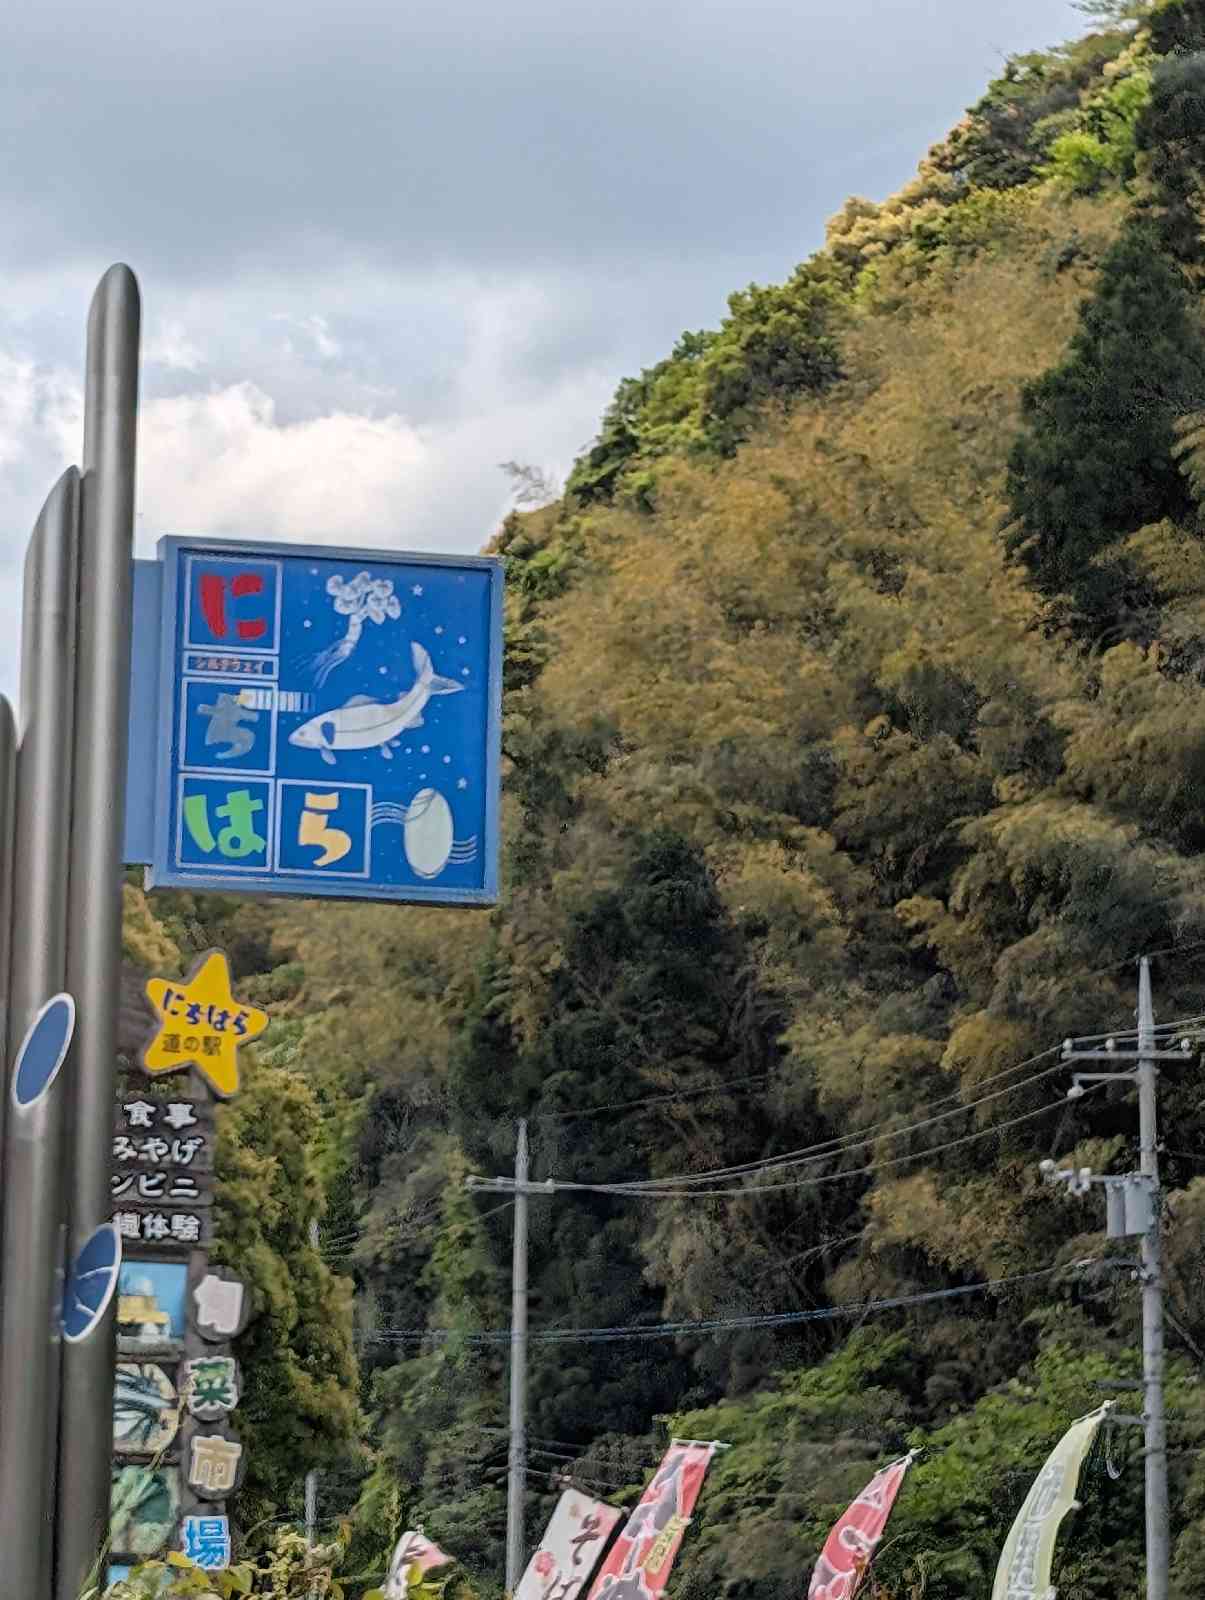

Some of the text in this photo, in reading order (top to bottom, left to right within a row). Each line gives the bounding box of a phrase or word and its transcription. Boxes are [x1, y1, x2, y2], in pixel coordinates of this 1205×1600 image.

[200, 574, 267, 640] に
[197, 692, 260, 760] ち
[163, 987, 249, 1035] にちはら
[162, 1033, 223, 1057] 道の駅
[123, 1100, 198, 1129] 食事
